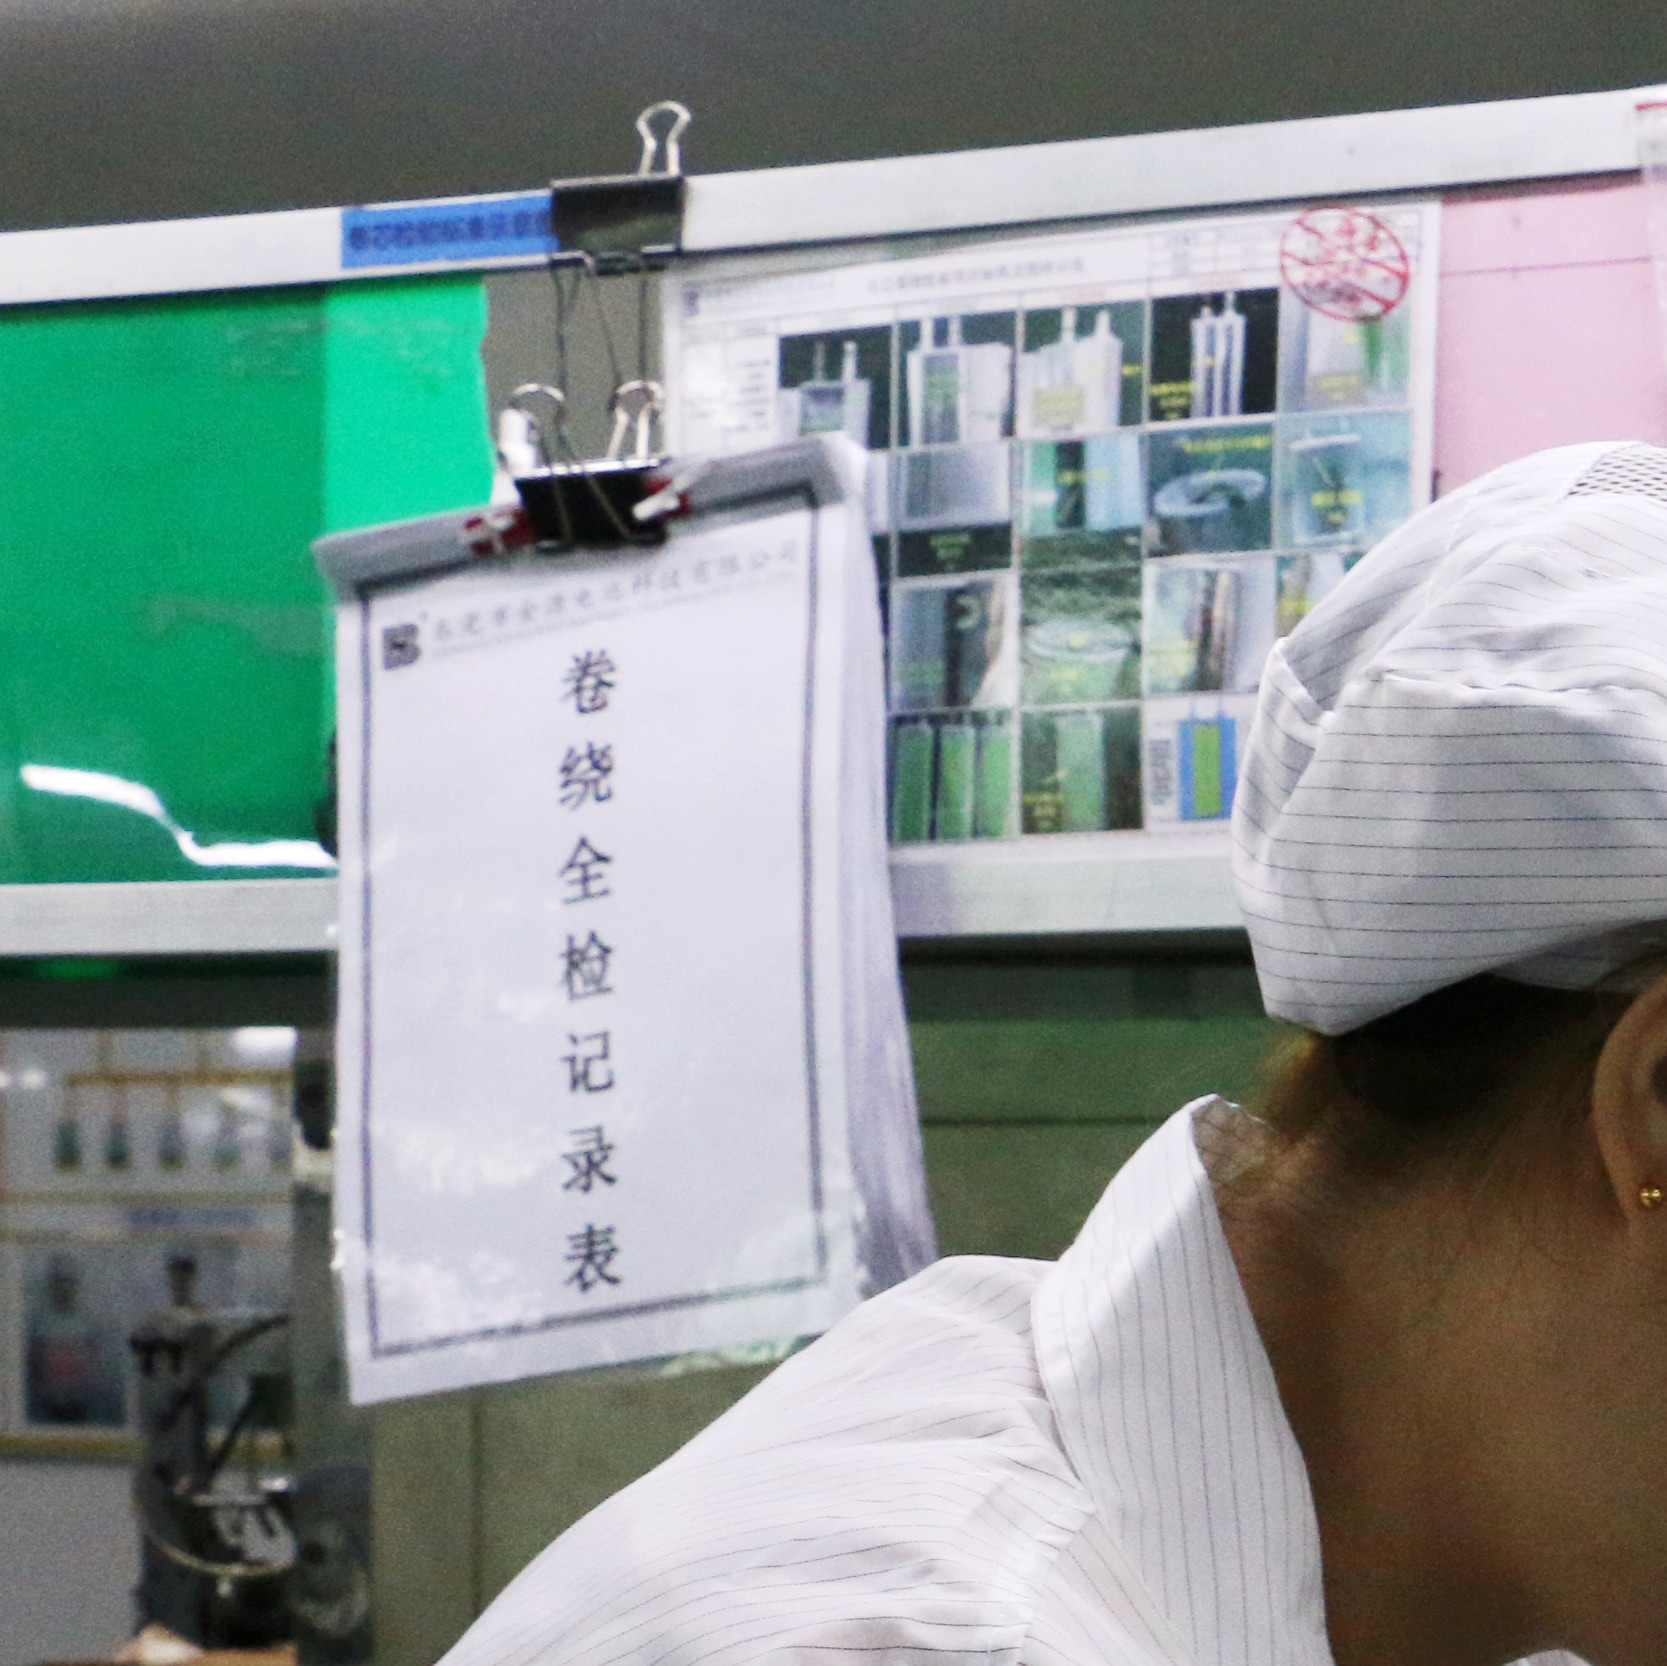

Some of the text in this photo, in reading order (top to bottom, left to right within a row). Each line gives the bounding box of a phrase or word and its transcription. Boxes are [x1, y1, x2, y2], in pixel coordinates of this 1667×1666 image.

[557, 650, 622, 1293] 卷绕全检记录表
